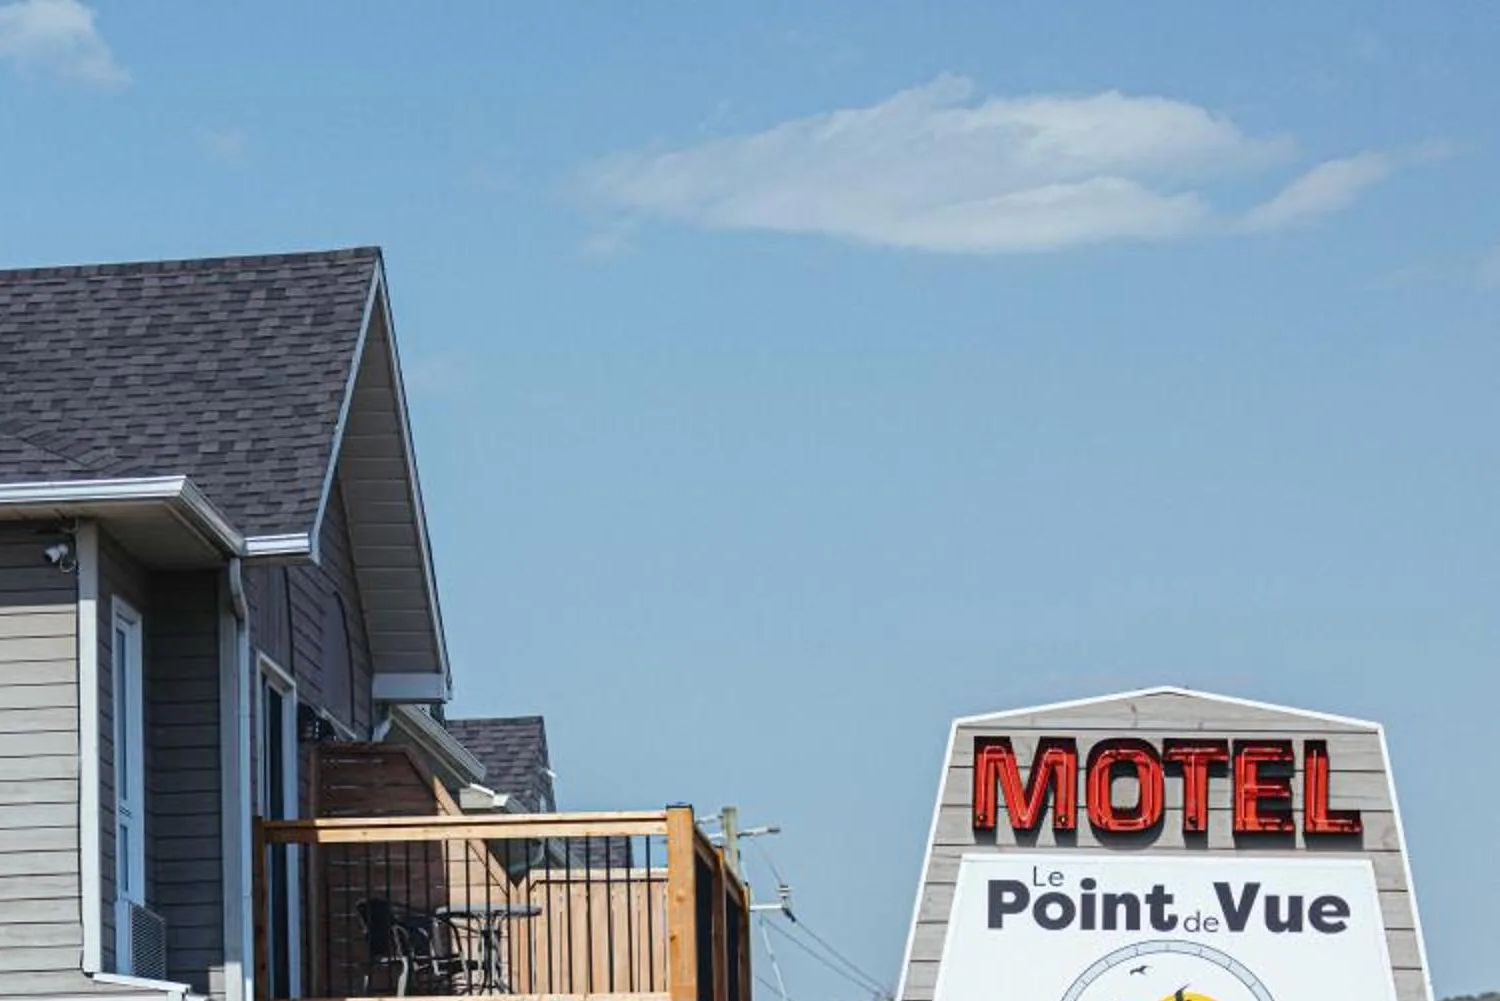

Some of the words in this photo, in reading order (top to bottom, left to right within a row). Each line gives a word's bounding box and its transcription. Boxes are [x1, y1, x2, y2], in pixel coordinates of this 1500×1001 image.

[973, 736, 1362, 834] MOTEL
[1033, 866, 1065, 888] Le
[987, 878, 1179, 932] Point
[1183, 910, 1220, 934] de
[1213, 881, 1351, 934] Vue
